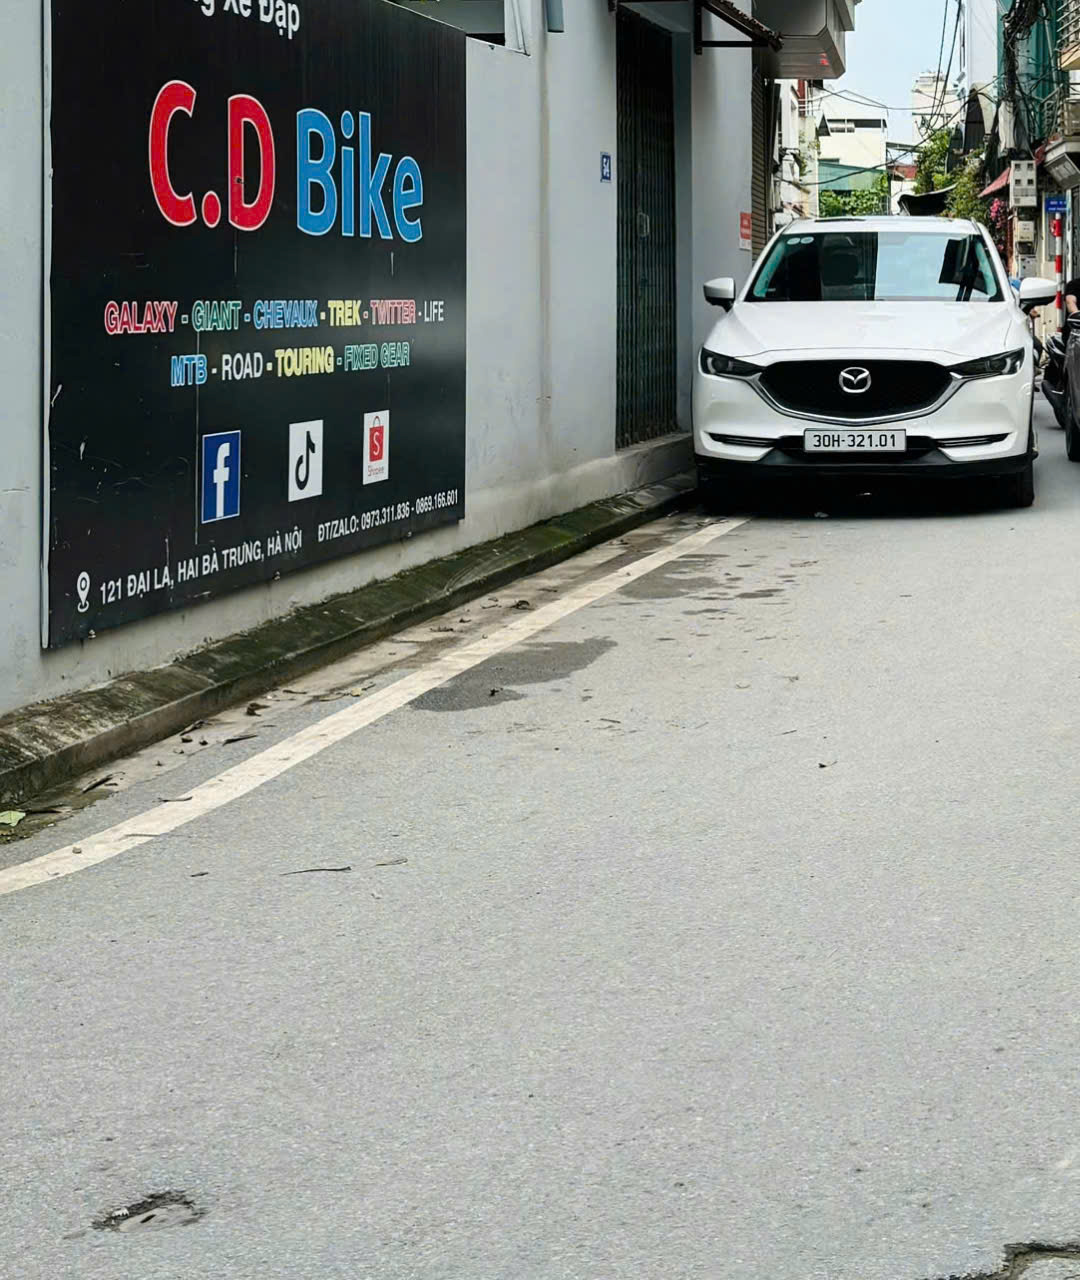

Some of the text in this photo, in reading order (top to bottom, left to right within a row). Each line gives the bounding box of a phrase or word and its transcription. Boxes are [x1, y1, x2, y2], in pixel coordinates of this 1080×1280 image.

[148, 79, 424, 243] C.D Bike
[104, 300, 178, 335] GALAXY
[192, 300, 242, 332] GIANT
[253, 299, 318, 329] CHEVAUX
[327, 299, 362, 326] TREK
[370, 299, 416, 325] TWITTER
[424, 300, 444, 322] LIFE
[170, 353, 208, 387] MTB
[221, 351, 263, 381] ROAD
[274, 346, 335, 377] TOURING
[344, 343, 378, 371] FIXED
[380, 341, 410, 368] GEAR
[813, 434, 896, 447] 30H-321.01
[100, 577, 122, 605] 121
[127, 570, 150, 598] ĐẠI
[178, 557, 199, 583] HAI
[202, 547, 219, 576] BÀ
[267, 530, 282, 557] HÀ
[285, 525, 302, 554] NỘI
[318, 515, 359, 542] ĐT/ZALO:
[361, 501, 410, 530] 0973.311.836
